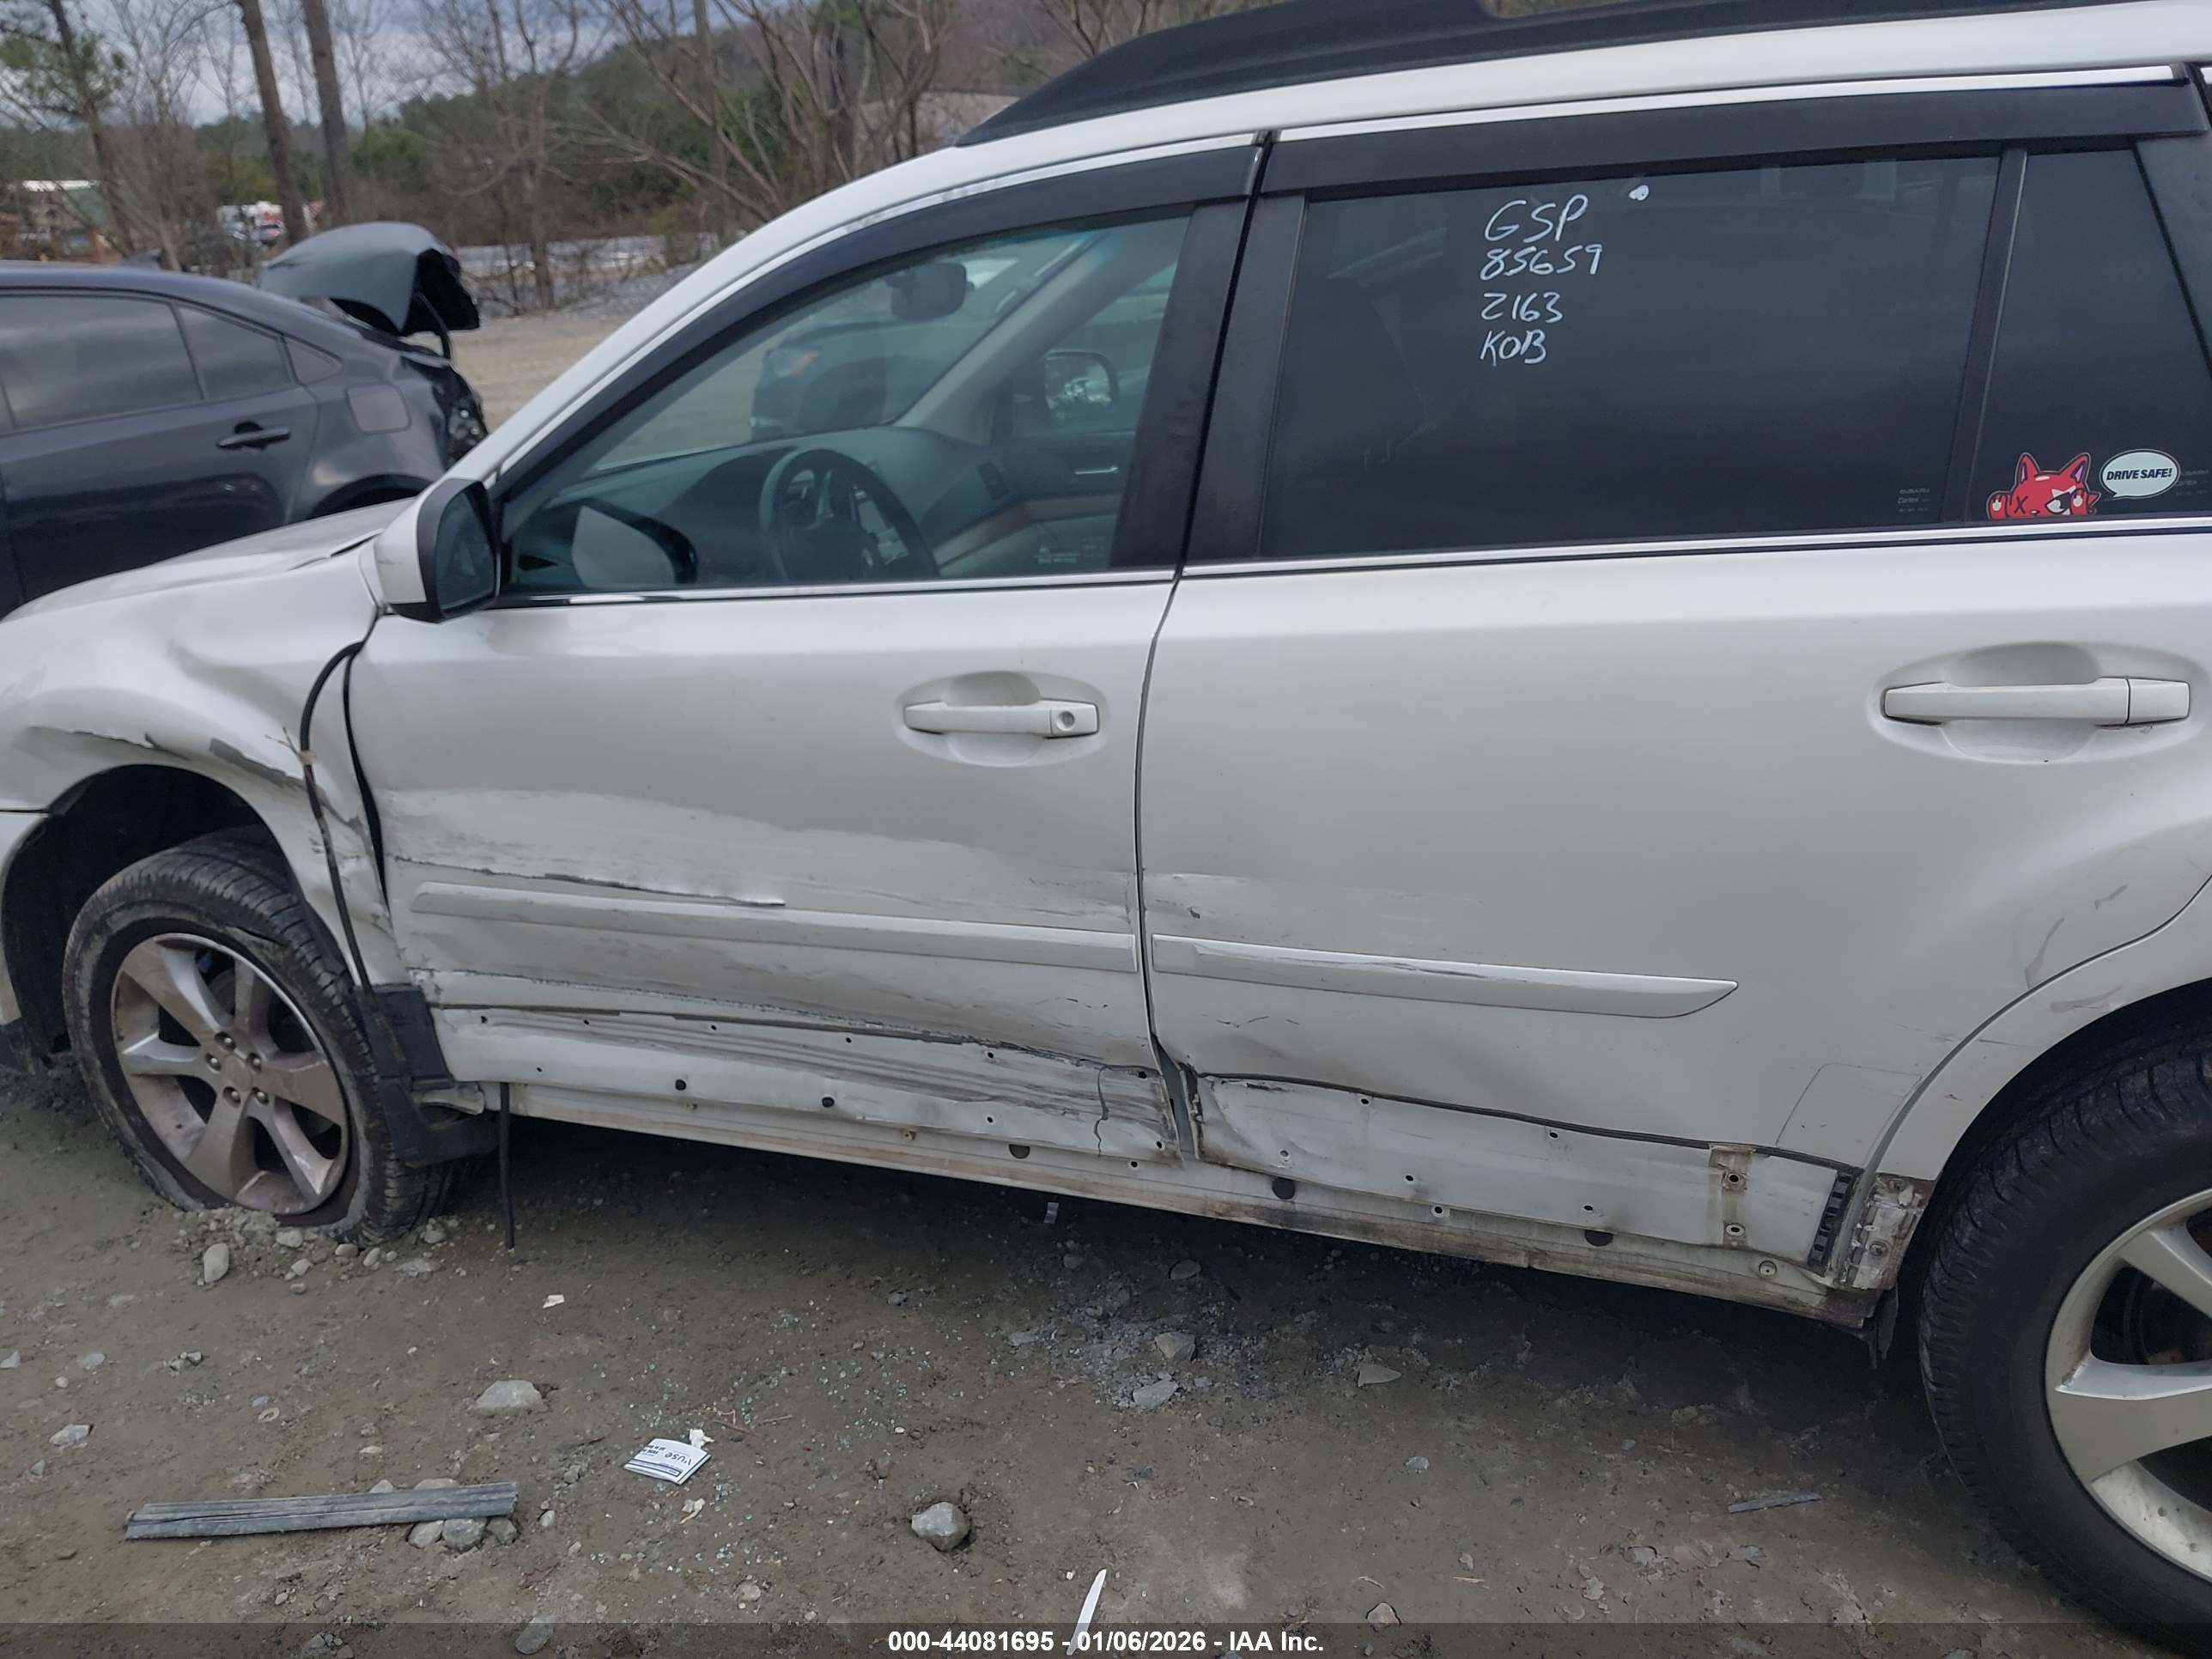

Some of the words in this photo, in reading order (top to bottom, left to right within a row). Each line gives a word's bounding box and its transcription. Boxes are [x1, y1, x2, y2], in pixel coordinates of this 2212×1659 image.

[1484, 194, 1589, 244] GSP
[1480, 243, 1603, 281] 85659
[1480, 292, 1563, 324] 2163
[2106, 470, 2141, 481] DRIVE
[2140, 467, 2172, 479] SAFE!
